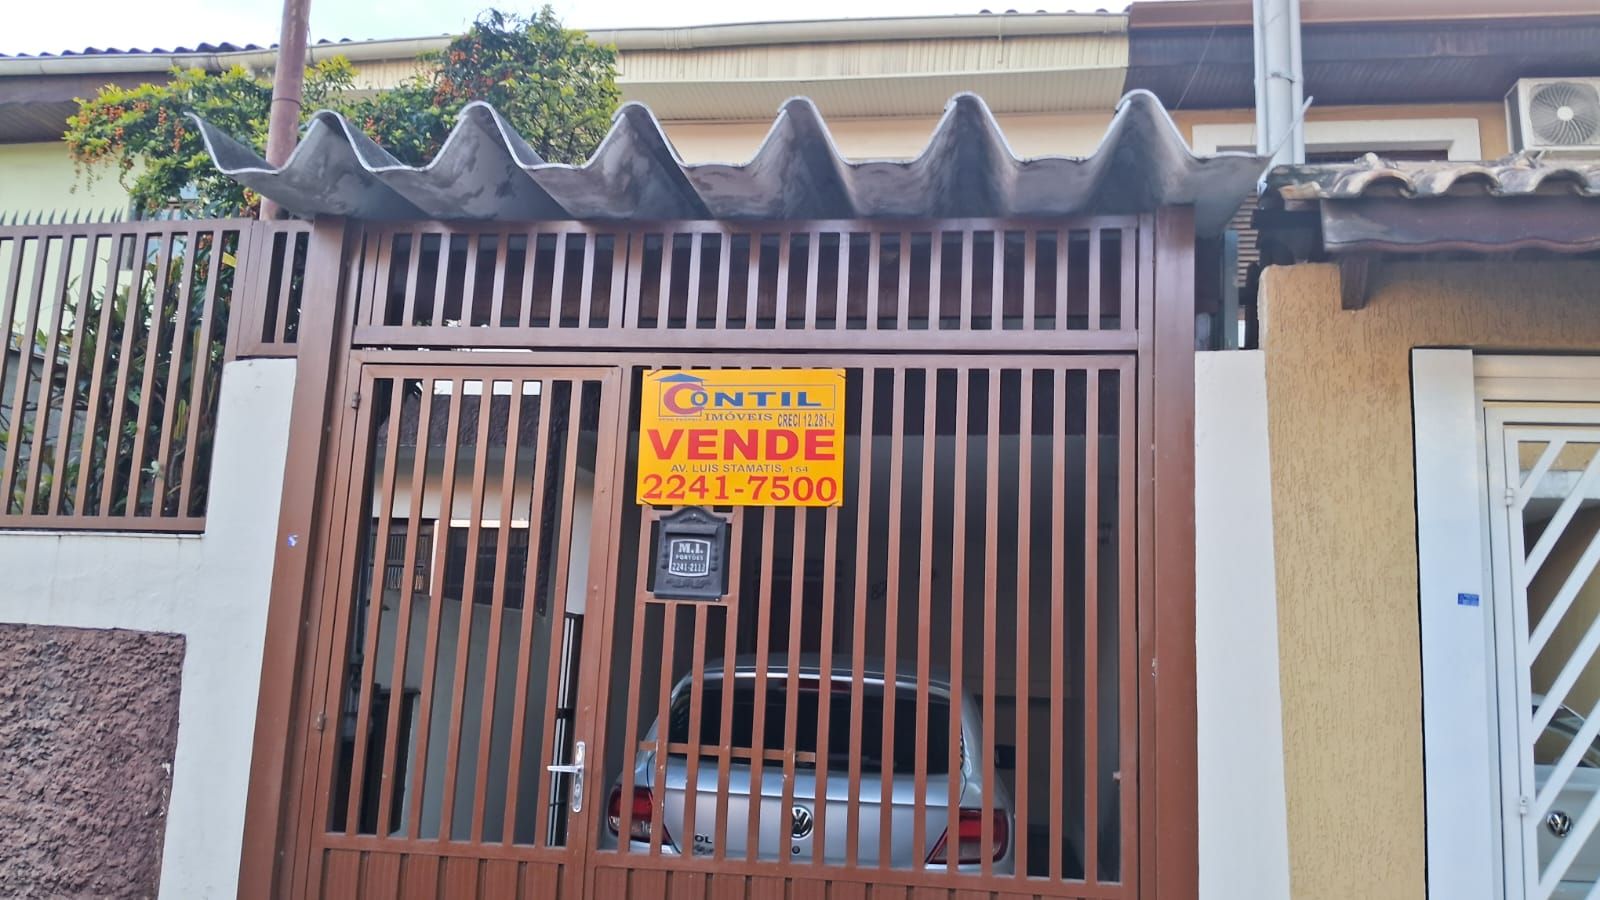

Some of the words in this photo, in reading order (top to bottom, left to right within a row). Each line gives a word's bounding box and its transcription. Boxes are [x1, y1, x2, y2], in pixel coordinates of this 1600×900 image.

[663, 383, 822, 415] CONTIL
[705, 411, 773, 421] IMÓVEIS
[777, 413, 800, 428] CRECI
[647, 429, 836, 461] VENDE
[670, 464, 688, 473] AV.
[692, 464, 719, 473] LUIS
[642, 473, 838, 502] 2241-7500
[694, 834, 713, 844] OL
